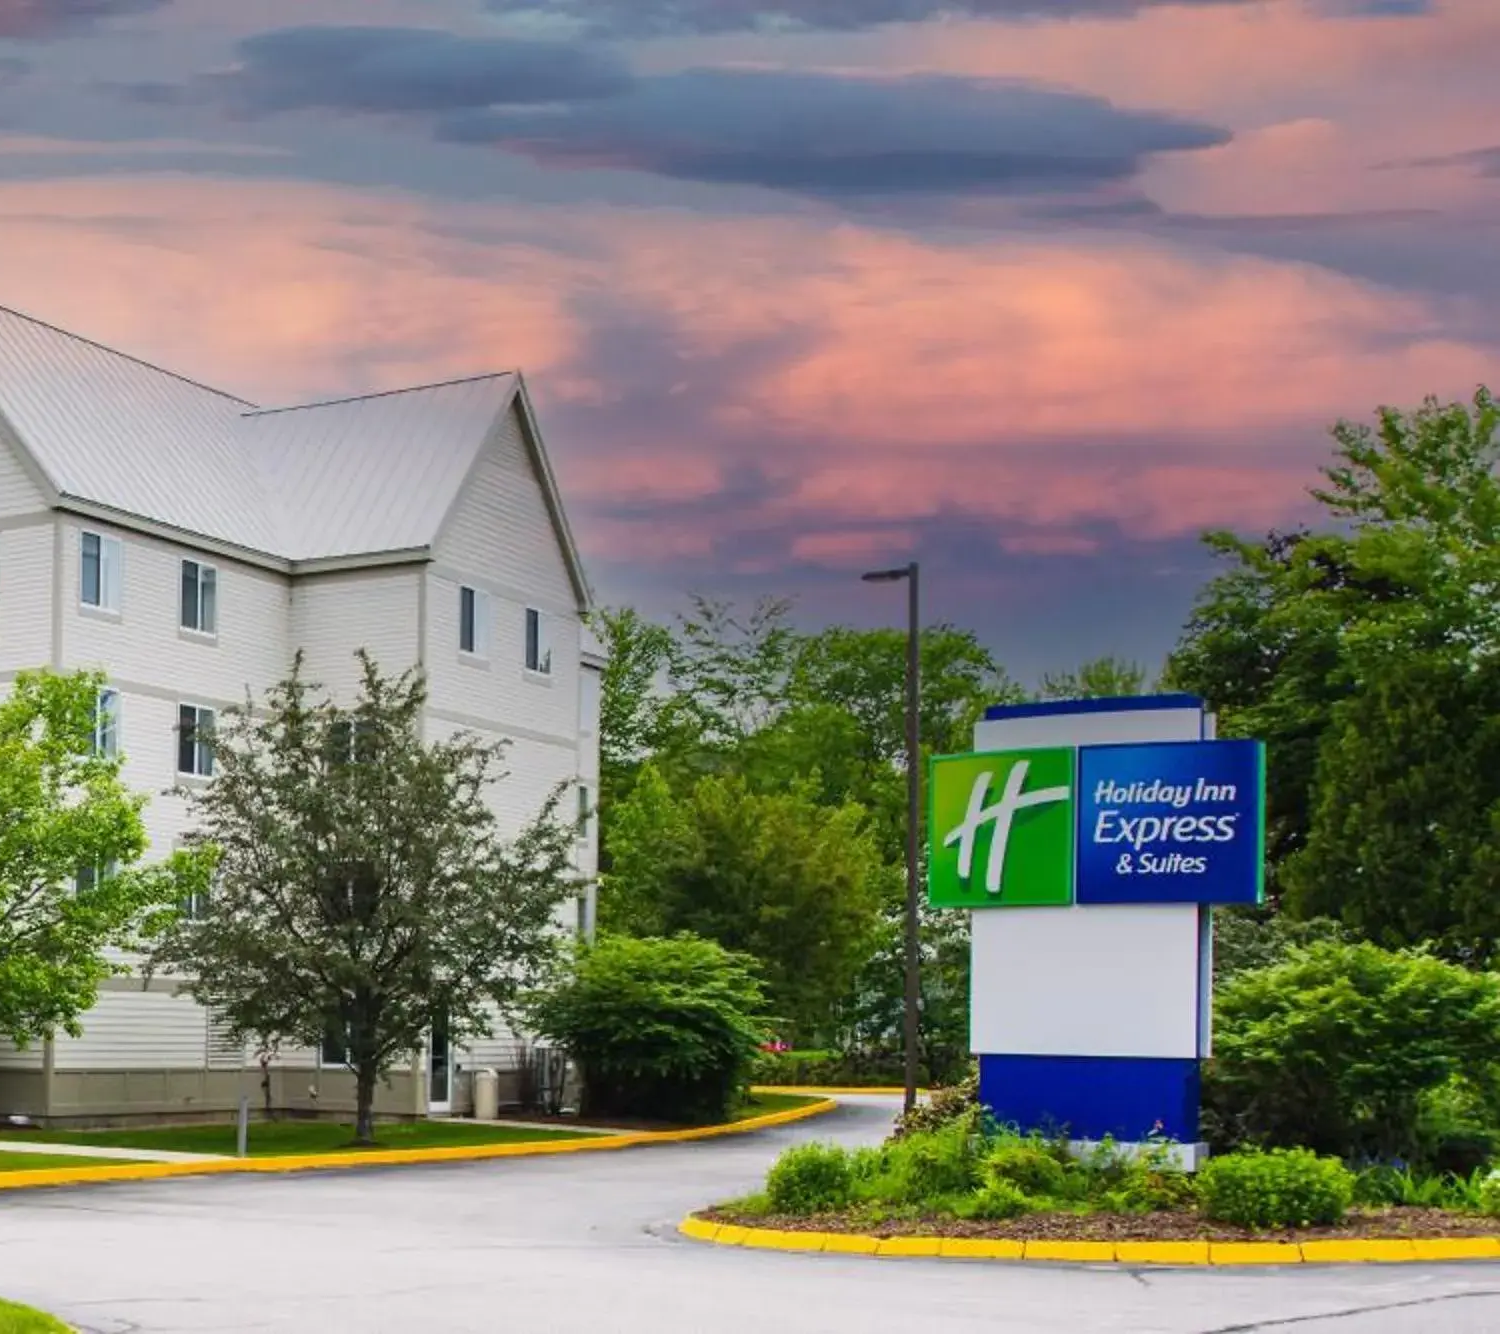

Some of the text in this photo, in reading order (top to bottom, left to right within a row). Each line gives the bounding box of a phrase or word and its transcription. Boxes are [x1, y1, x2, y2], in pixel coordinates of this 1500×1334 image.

[1094, 778, 1237, 807] Holiday Inn
[943, 760, 1070, 893] H
[1093, 810, 1236, 851] Express
[1116, 852, 1207, 874] & Suites
